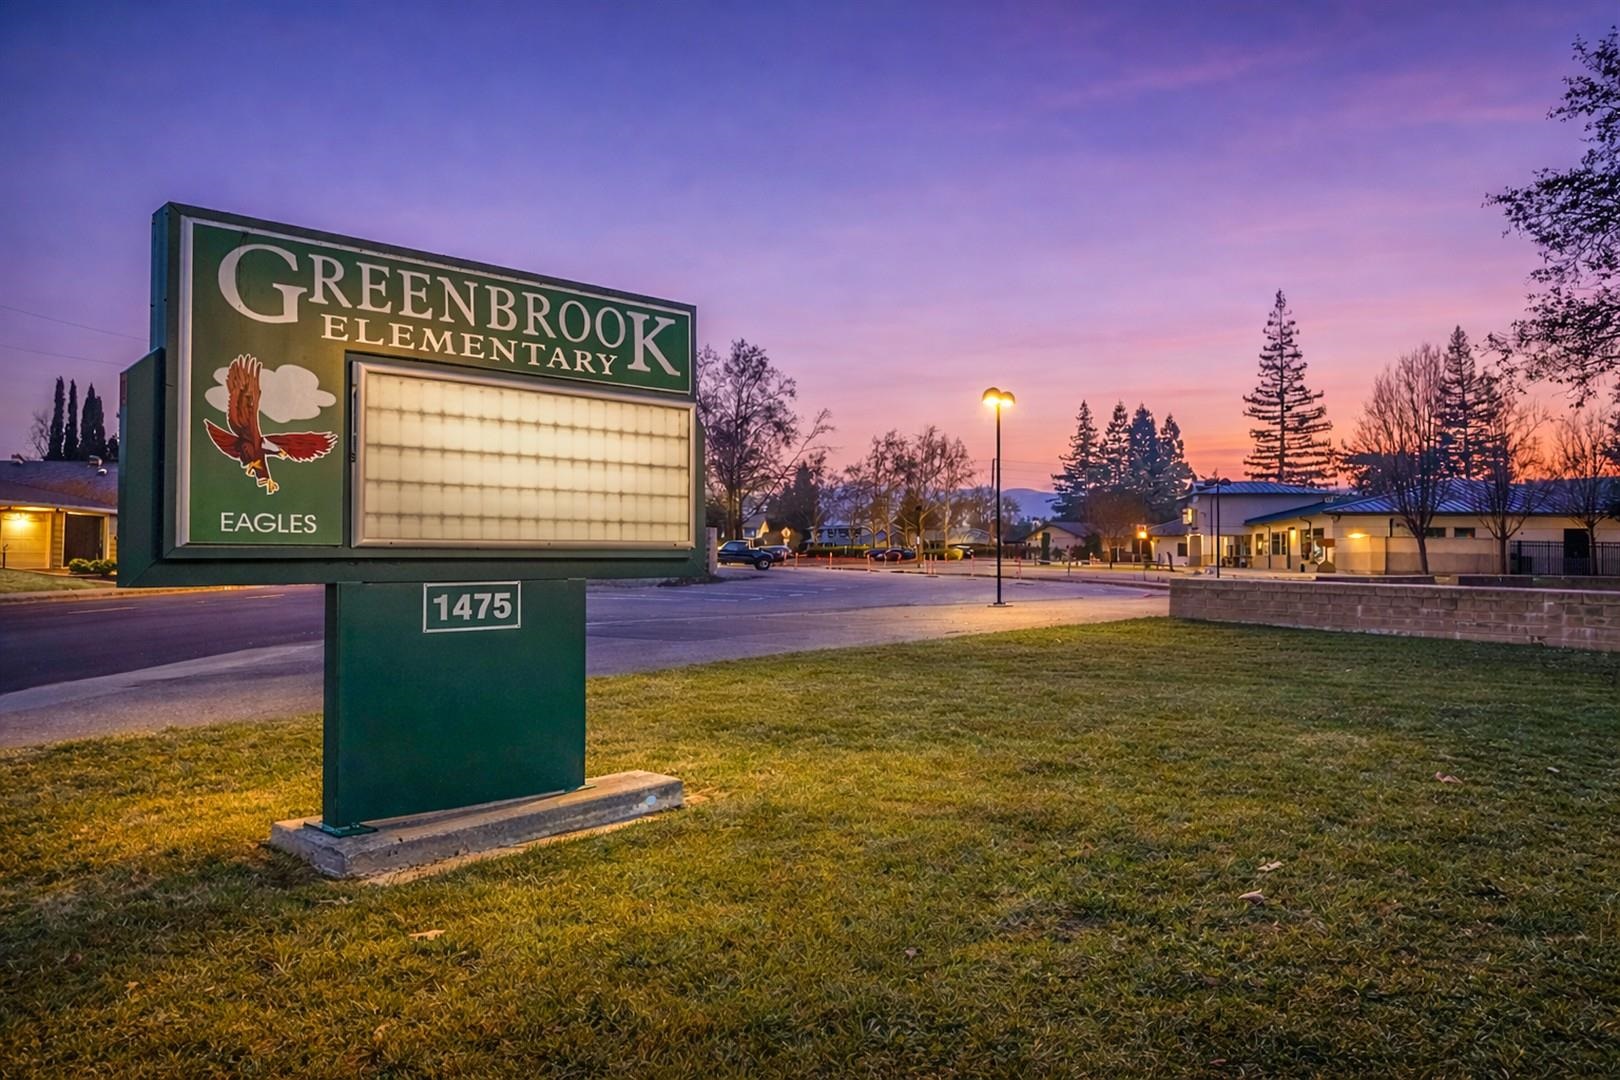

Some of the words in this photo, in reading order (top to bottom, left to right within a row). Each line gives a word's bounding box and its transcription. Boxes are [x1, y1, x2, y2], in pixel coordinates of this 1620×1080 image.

[218, 244, 680, 376] GREENBROOK
[321, 315, 618, 375] ELEMENTARY
[220, 512, 317, 533] EAGLES
[433, 592, 512, 621] 1475
